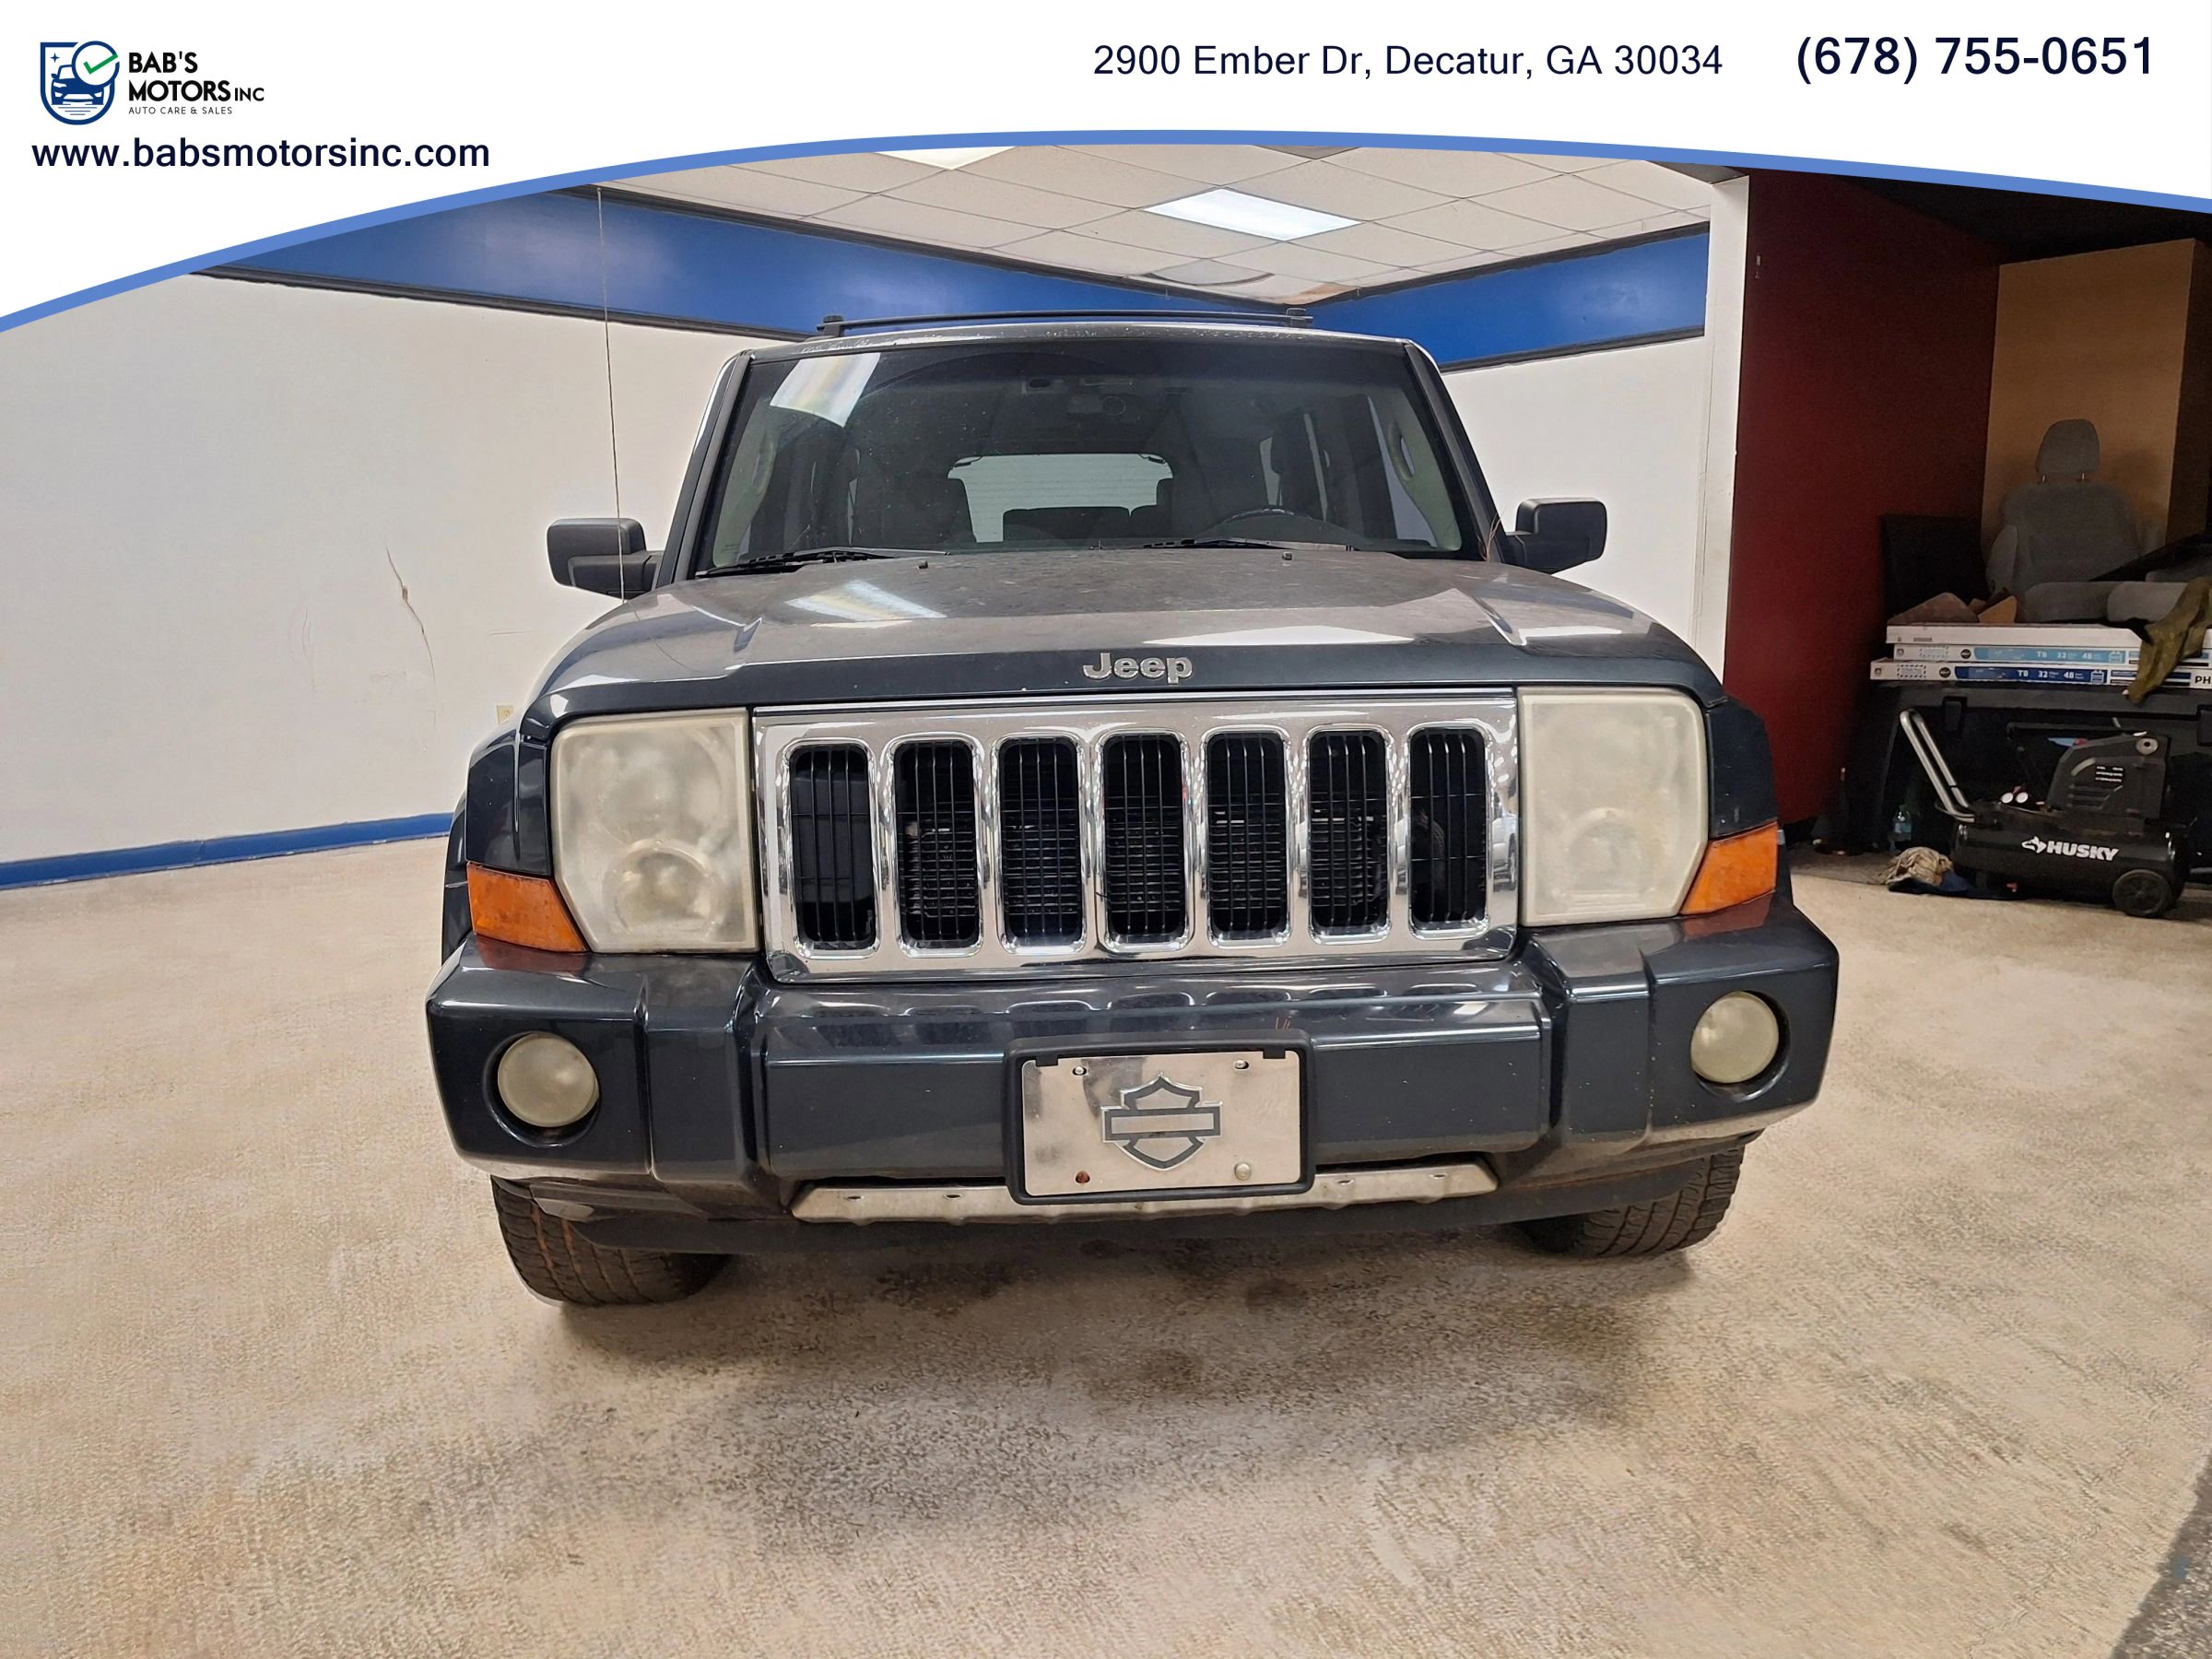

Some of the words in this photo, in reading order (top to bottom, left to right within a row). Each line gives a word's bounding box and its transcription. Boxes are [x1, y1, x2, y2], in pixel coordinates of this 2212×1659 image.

[1082, 652, 1193, 684] Jeep
[2038, 670, 2049, 678] 32
[2046, 840, 2119, 862] HUSKY
